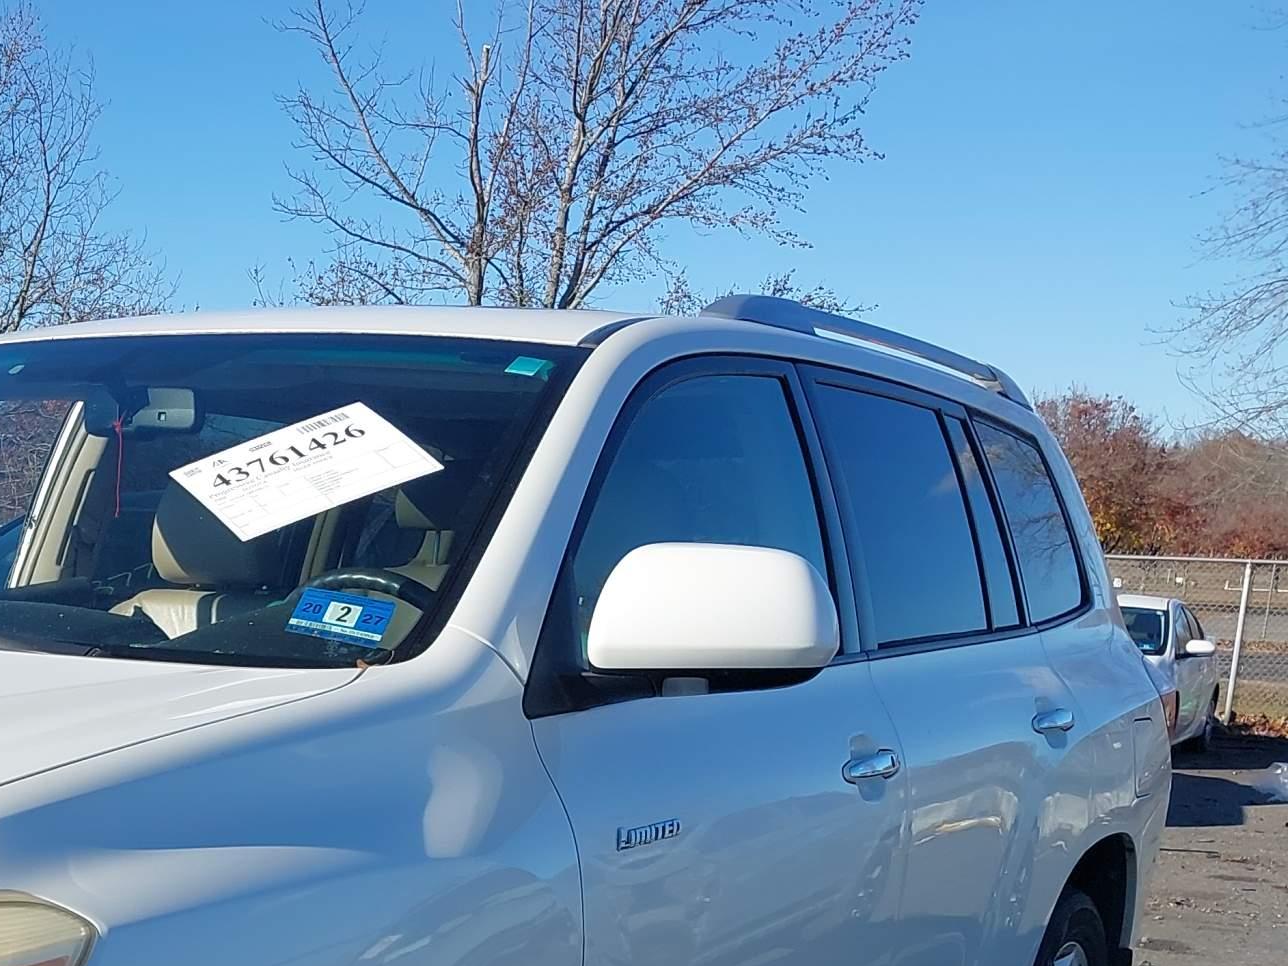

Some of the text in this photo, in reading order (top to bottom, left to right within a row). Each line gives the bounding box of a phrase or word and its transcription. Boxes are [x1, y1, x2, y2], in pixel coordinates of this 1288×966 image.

[212, 423, 366, 488] 43761426
[302, 602, 323, 615] 20
[335, 606, 353, 623] 2
[616, 817, 680, 852] LIMITED
